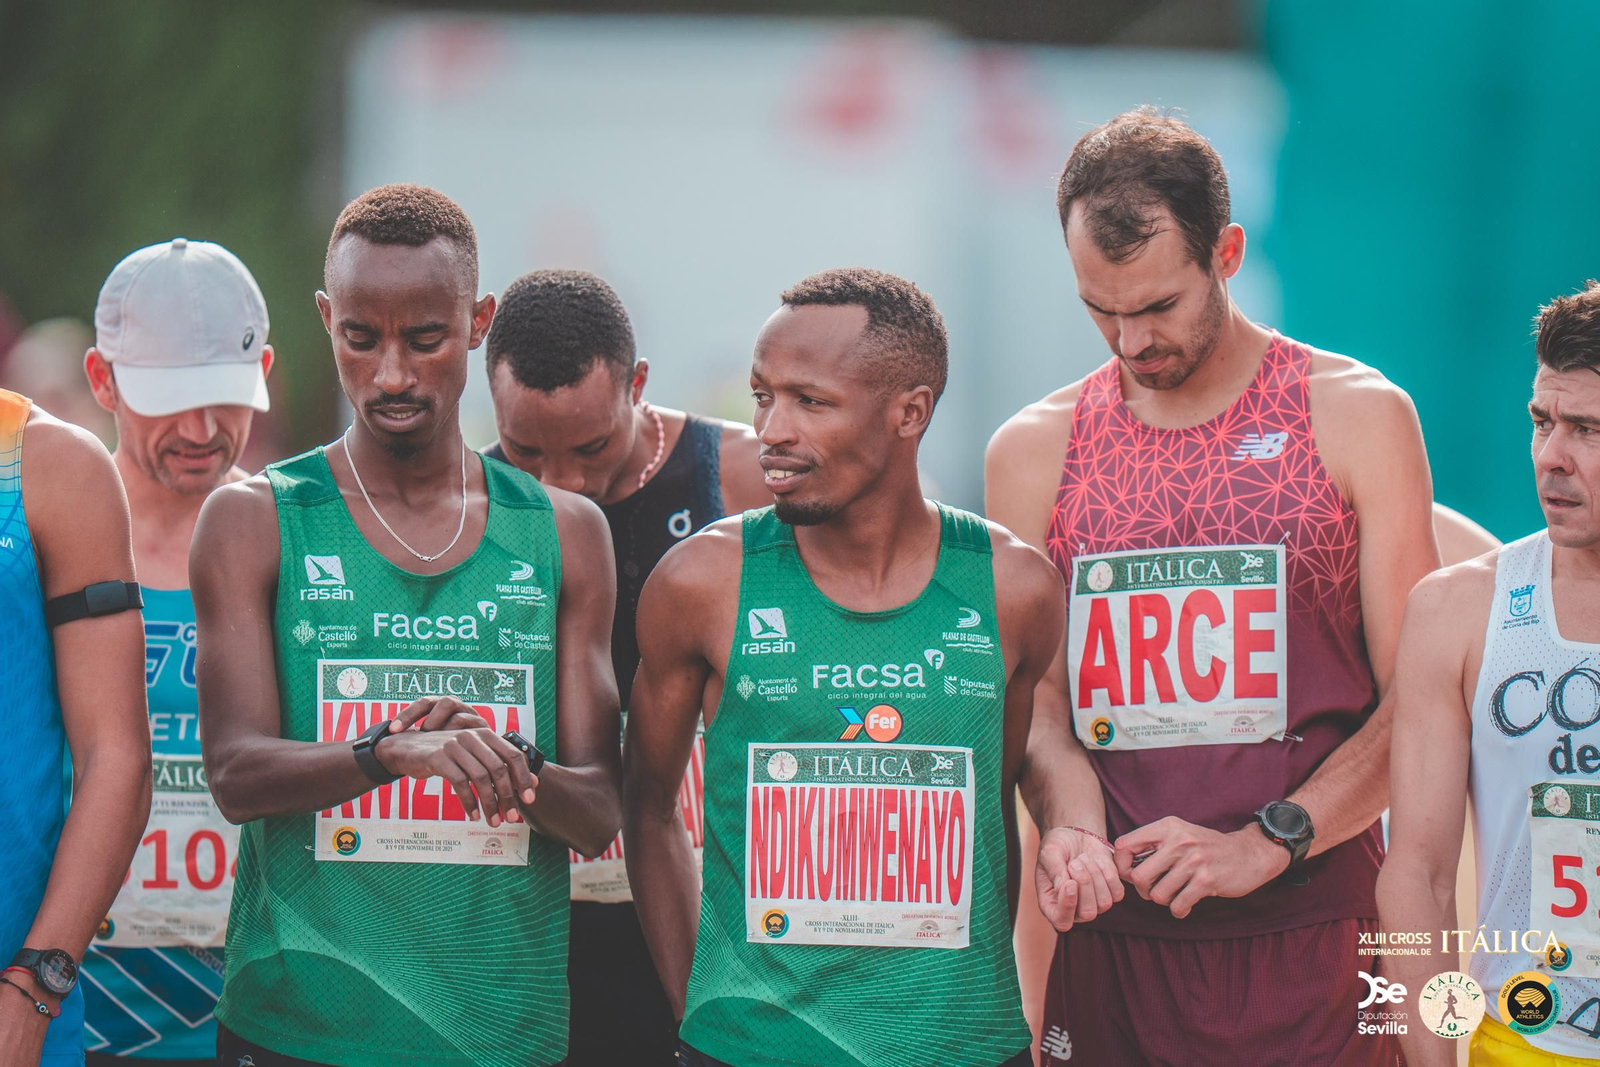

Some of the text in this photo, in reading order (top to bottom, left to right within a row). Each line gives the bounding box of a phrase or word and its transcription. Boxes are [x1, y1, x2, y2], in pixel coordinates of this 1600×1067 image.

[1126, 556, 1224, 583] ITÁLICA
[1127, 581, 1173, 589] INTERNATIONAL
[1241, 575, 1265, 583] Sevilla
[300, 586, 354, 601] rasán
[373, 612, 480, 640] Facsa
[318, 630, 357, 641] Castelló
[514, 631, 550, 641] Diputació
[942, 632, 959, 640] PLAYAS
[960, 633, 967, 641] DE
[410, 643, 441, 652] integral
[514, 640, 523, 648] de
[742, 638, 796, 655] rasán
[1078, 589, 1278, 709] ARCE
[383, 668, 480, 696] ITÁLICA
[812, 663, 926, 689] Facsa
[757, 683, 798, 695] Castelló
[960, 679, 995, 690] Diputació
[494, 694, 516, 703] Sevilla
[827, 692, 849, 700] ciclo
[852, 692, 886, 701] integral
[869, 713, 897, 729] Fer
[1548, 732, 1600, 775] de
[813, 751, 915, 778] ITÁLICA
[152, 760, 209, 788] ÁLIC
[931, 777, 954, 785] Sevilla
[750, 786, 966, 906] NDIKUMWENAYO
[122, 829, 238, 890] 10
[1551, 855, 1600, 918] 5
